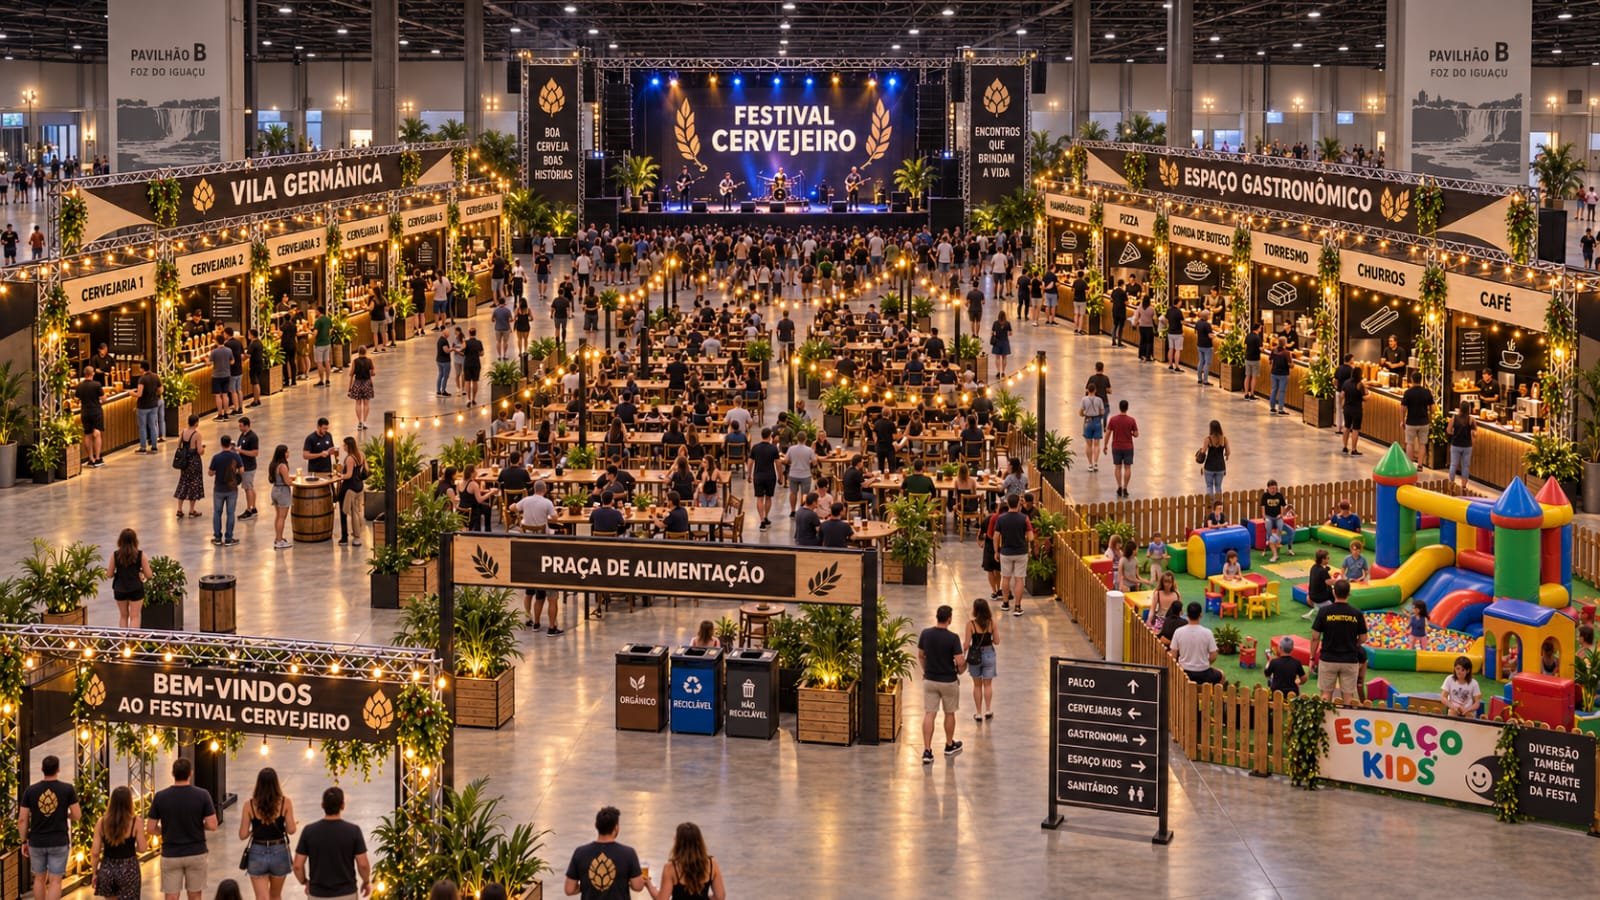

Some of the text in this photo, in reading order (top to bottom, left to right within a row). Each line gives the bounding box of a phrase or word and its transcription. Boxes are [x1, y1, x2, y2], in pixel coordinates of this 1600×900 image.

[131, 42, 207, 62] PAVILHÃO B
[1429, 41, 1509, 62] PAVILHÃO B
[130, 67, 205, 80] FOZ DO IGUAÇU
[1430, 68, 1508, 79] FOZ DO IGUAÇU
[735, 105, 835, 126] FESTIVAL
[545, 127, 560, 138] BOA
[975, 126, 1021, 137] ENCONTROS
[536, 141, 569, 152] CERVEJA
[712, 129, 857, 156] CERVEJEIRO
[988, 140, 1005, 151] QUE
[543, 155, 564, 166] BOAS
[978, 153, 1015, 164] BRINDAM
[534, 166, 573, 180] HISTÓRIAS
[982, 167, 1010, 178] A VIDA
[231, 161, 383, 205] VILA GERMÂNICA
[1184, 167, 1373, 212] ESPAÇO GASTRONÔMICO
[1120, 213, 1140, 227] PIZZA
[346, 225, 379, 241] CERVEJARIA
[1172, 224, 1231, 247] COMIDA DE BOTECO
[277, 237, 321, 257] CERVEJARIA 3
[1263, 242, 1309, 265] TORRESMO
[191, 253, 245, 277] CERVEJARIA 2
[1357, 263, 1406, 287] CHURROS
[81, 275, 144, 302] CERVEJARIA 1
[1480, 291, 1512, 313] CAFÉ
[541, 555, 765, 588] PRAÇA DE ALIMENTAÇÃO
[153, 673, 312, 706] BEM-VINDOS
[1068, 677, 1096, 689] PALCO
[620, 694, 657, 706] ORGÂNICO
[673, 699, 712, 710] RECICLÁVEL
[741, 700, 755, 710] NÃO
[118, 697, 350, 731] AO FESTIVAL CERVEJEIRO
[729, 709, 767, 719] RECICLÁVEL
[1067, 703, 1122, 717] CERVEJARIAS
[1067, 728, 1128, 744] GASTRONOMIA
[1334, 718, 1463, 757] ESPAÇO
[1529, 742, 1579, 760] DIVERSÃO
[1067, 754, 1122, 769] ESPAÇO KIDS
[1362, 750, 1436, 785] KIDS
[1533, 757, 1575, 773] TAMBÉM
[1067, 780, 1119, 795] SANITÁRIOS
[1528, 771, 1581, 789] FAZ PARTE
[1530, 785, 1578, 804] DA FESTA
